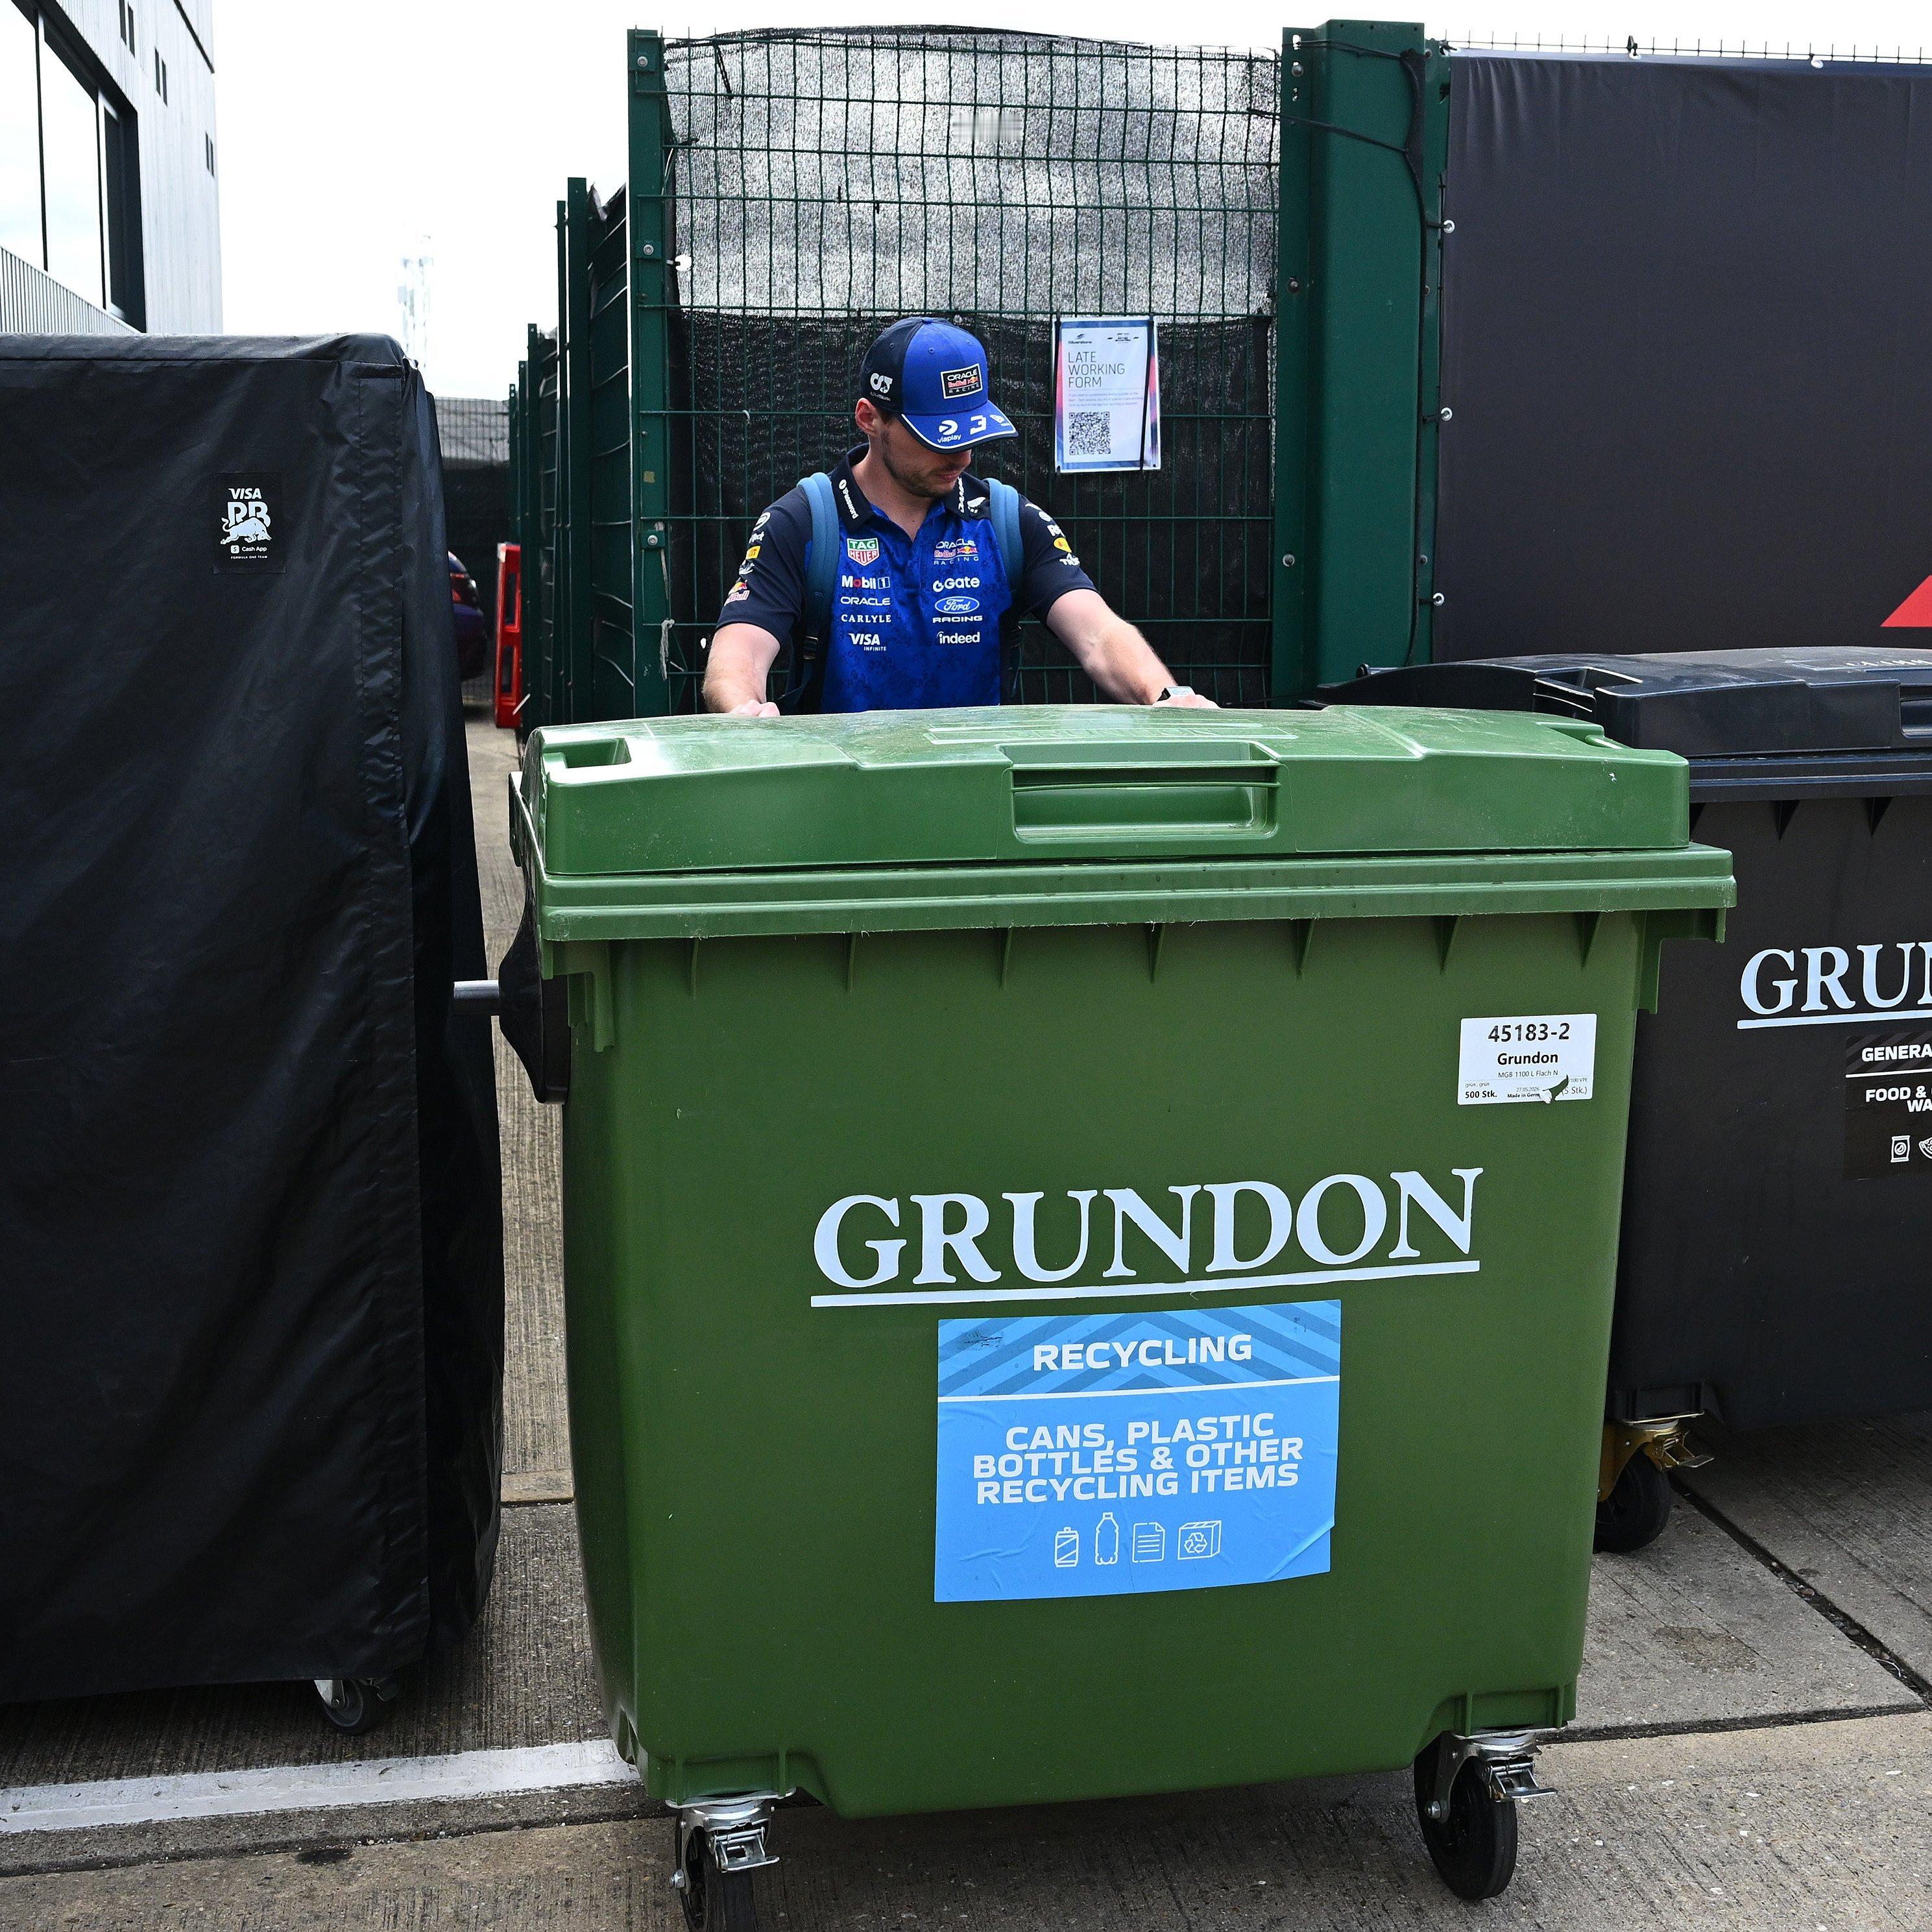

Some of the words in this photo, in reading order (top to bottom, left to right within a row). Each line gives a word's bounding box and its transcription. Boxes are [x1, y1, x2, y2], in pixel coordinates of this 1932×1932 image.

[1068, 351, 1096, 363] LATE
[947, 368, 978, 381] ORACLE
[1068, 363, 1126, 376] WORKING
[948, 383, 980, 393] RACING
[1069, 376, 1102, 388] FORM
[937, 433, 961, 443] viaplay
[228, 488, 262, 500] VISA
[849, 540, 876, 549] TAG
[936, 538, 976, 549] ORACLE
[850, 550, 878, 564] HEUER
[934, 556, 979, 565] RACING
[841, 575, 876, 590] Mobil
[944, 576, 980, 590] Gate
[840, 596, 891, 606] ORACLE
[943, 599, 971, 611] Ford
[841, 614, 891, 623] CARLYLE
[932, 615, 983, 623] RACING
[848, 633, 880, 645] VISA
[937, 631, 980, 644] indeed
[1740, 941, 1932, 1015] GRU
[1488, 1022, 1571, 1043] 45183-2
[1497, 1051, 1558, 1065] Grundon
[1861, 1043, 1932, 1062] GENERA
[1866, 1087, 1911, 1102] FOOD
[1916, 1085, 1927, 1098] &
[813, 1168, 1483, 1288] GRUNDON
[1033, 1334, 1252, 1371] RECYCLING
[1006, 1423, 1115, 1453] CANS,
[1127, 1413, 1274, 1445] PLASTIC
[973, 1448, 1138, 1479] BOTTLES
[1150, 1446, 1174, 1470] &
[1185, 1437, 1303, 1467] OTHER
[976, 1473, 1178, 1504] RECYCLING
[1191, 1463, 1299, 1493] ITEMS
